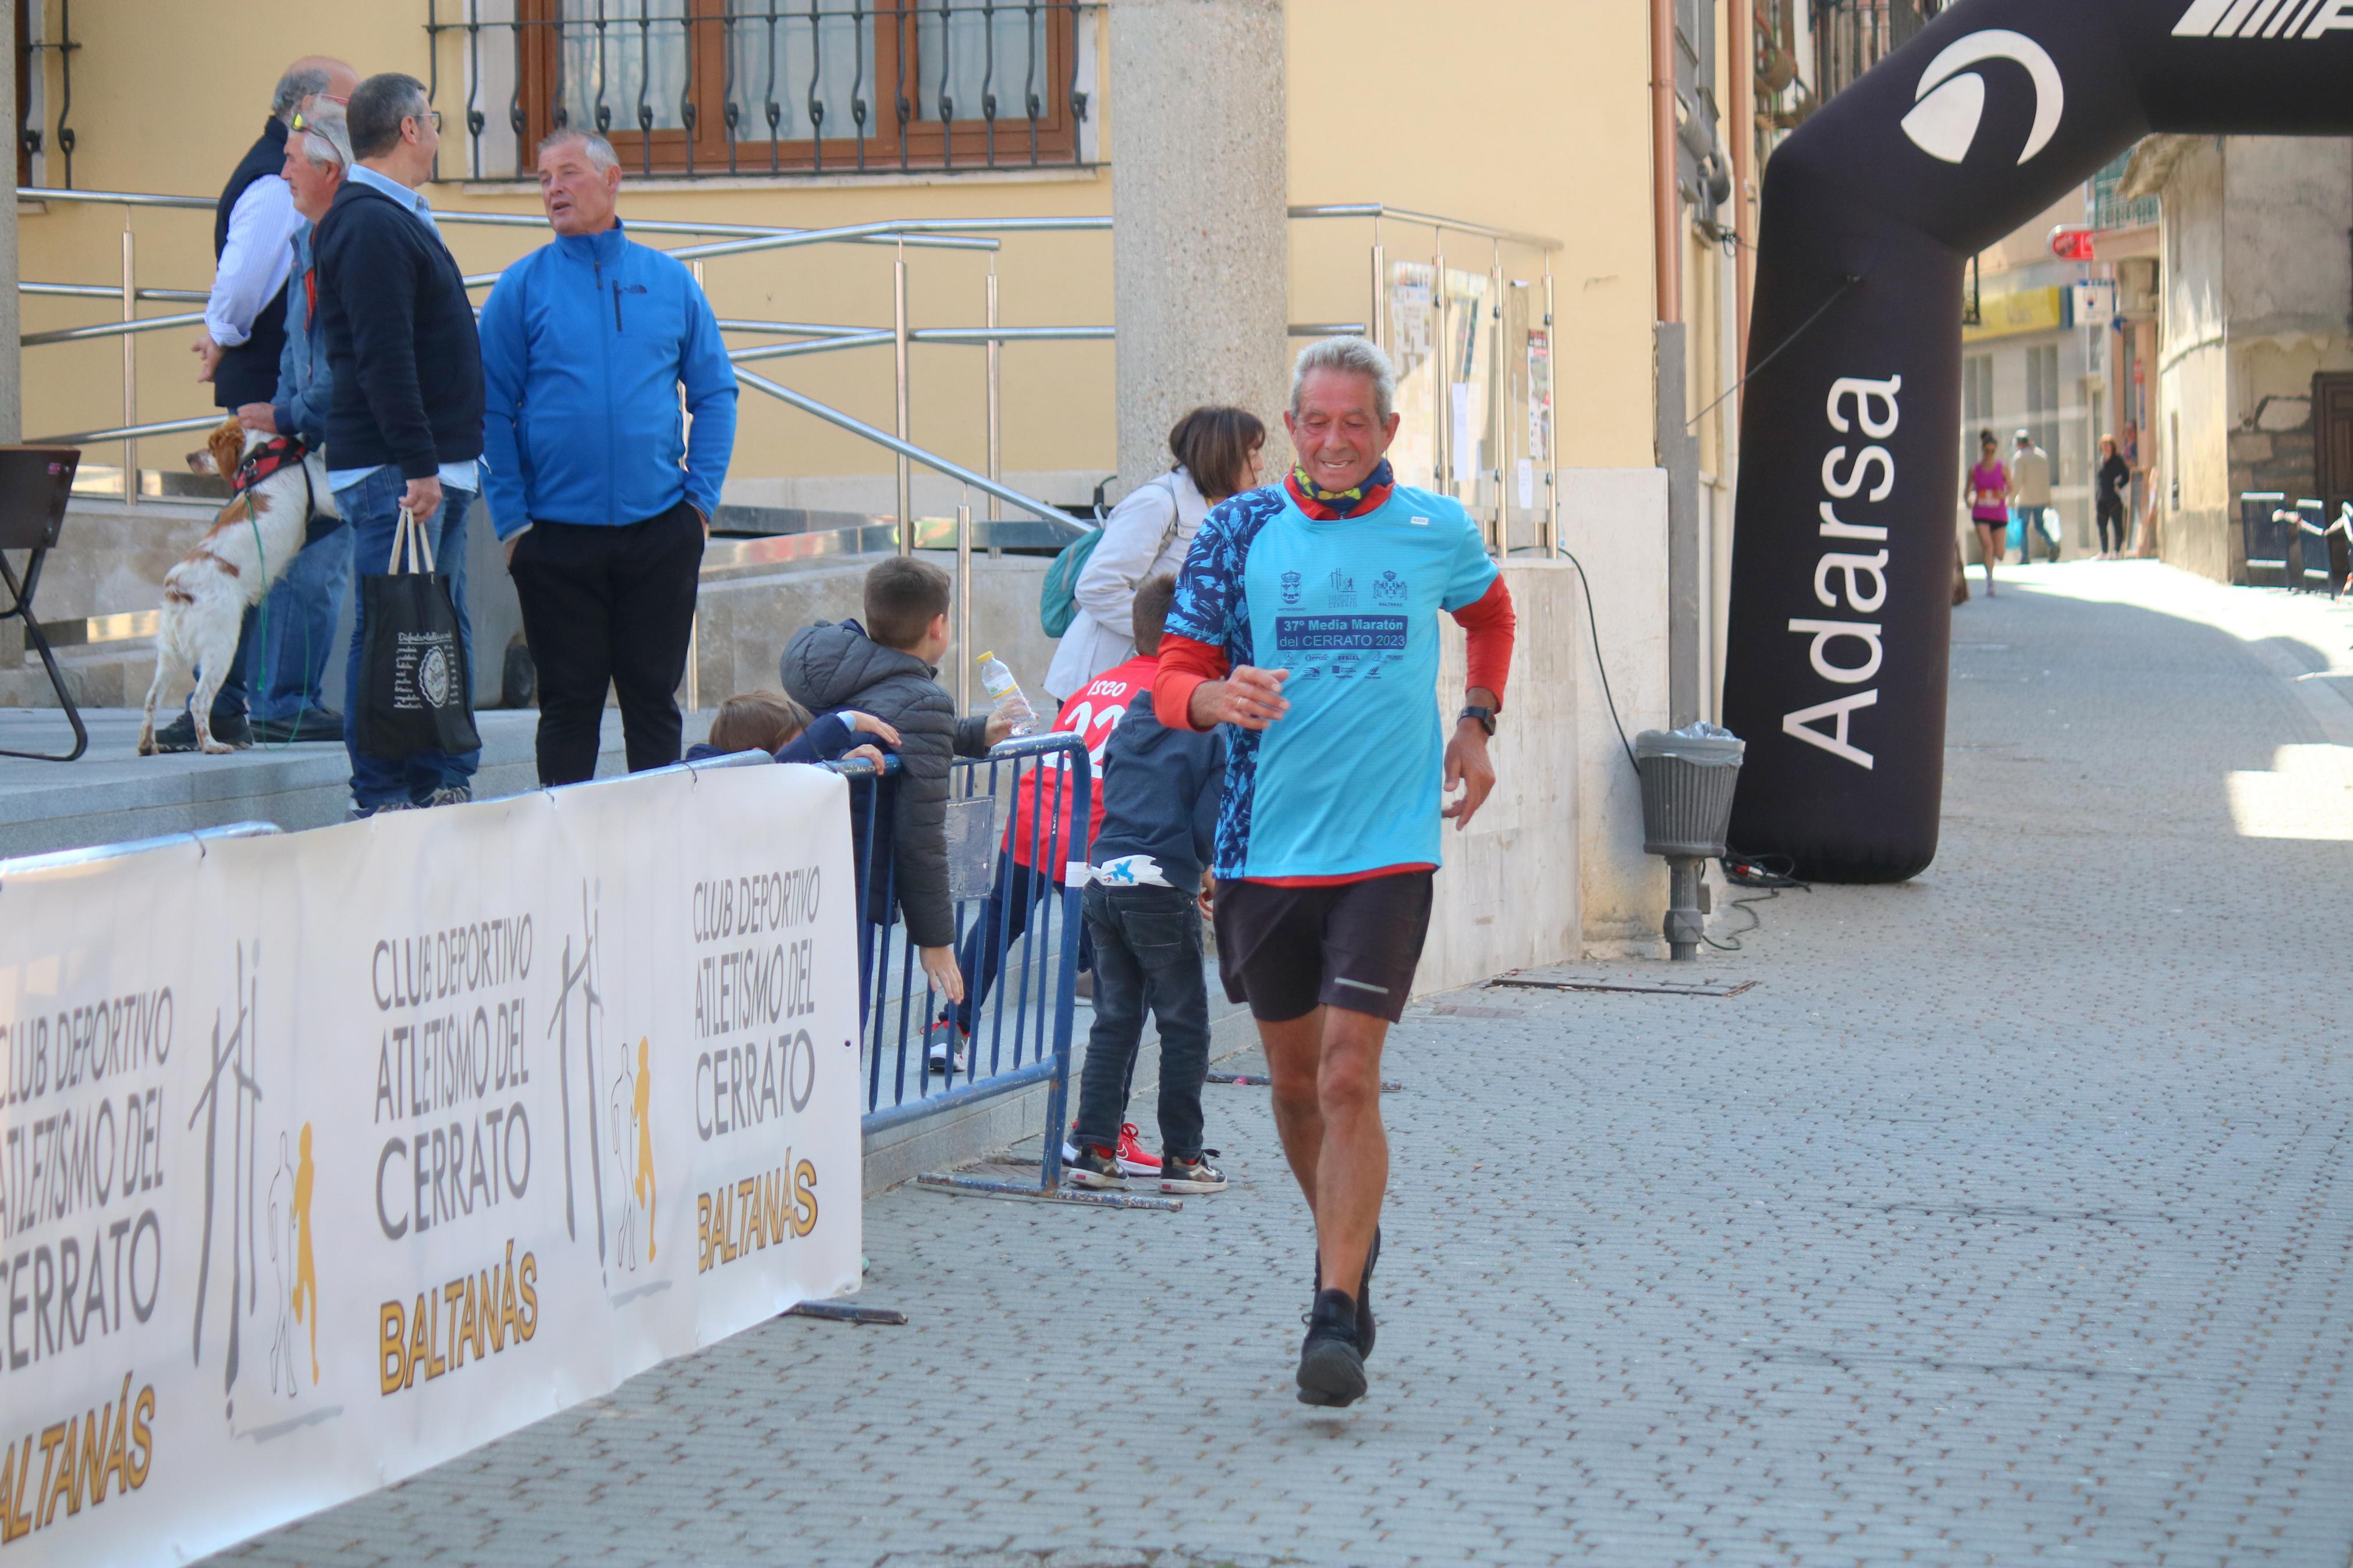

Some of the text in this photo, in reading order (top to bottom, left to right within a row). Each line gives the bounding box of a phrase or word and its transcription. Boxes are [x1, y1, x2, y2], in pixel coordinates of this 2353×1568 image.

[1309, 619, 1347, 631] Media
[1351, 618, 1403, 630] Maratón
[1781, 373, 1902, 770] Adarsa
[1086, 680, 1127, 697] ISCO
[1280, 634, 1406, 648] del CERRATO 2023
[693, 865, 821, 944] CLUB DEPORTIVO
[372, 912, 533, 1011] CLUB DEPORTIVO
[695, 938, 815, 1040] ATLETISMO DEL
[55, 986, 173, 1093] DEPORTIVO
[374, 996, 529, 1125] ATLETISMO DEL
[696, 1028, 815, 1142] CERRATO
[123, 1085, 164, 1198] DEL
[375, 1100, 531, 1240] CERRATO
[698, 1146, 818, 1275] BALTANÁS
[379, 1238, 538, 1397] BALTANÁS
[0, 1370, 155, 1545] ALTANÁS
